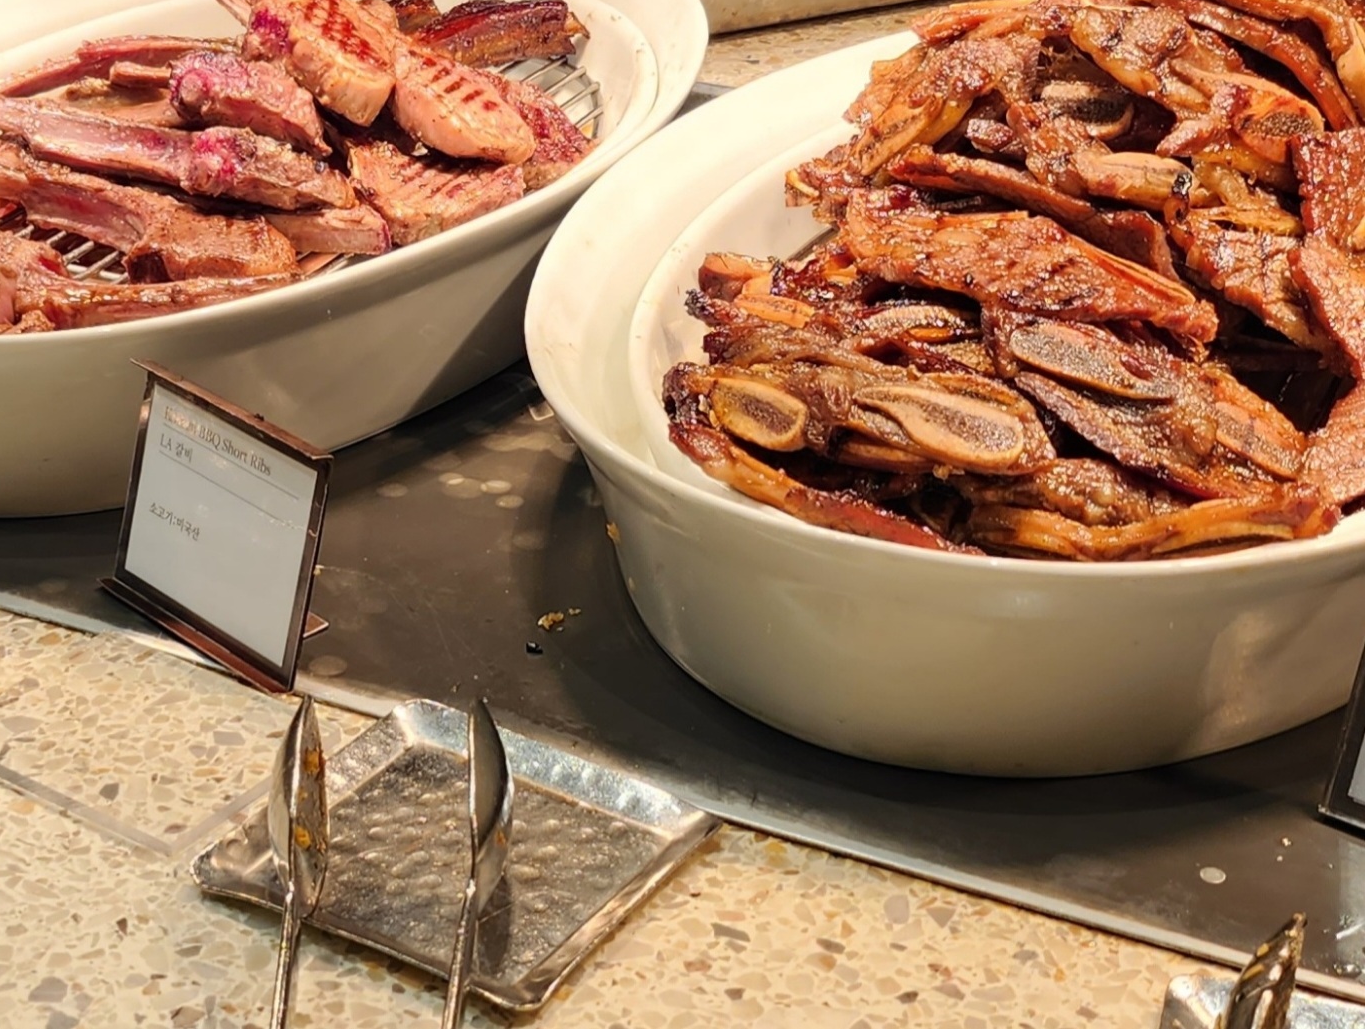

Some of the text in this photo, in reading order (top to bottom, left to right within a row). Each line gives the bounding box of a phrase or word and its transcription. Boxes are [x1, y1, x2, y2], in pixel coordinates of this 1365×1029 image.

[159, 433, 193, 463] LA 갈비
[198, 424, 221, 451] BBQ
[222, 438, 248, 463] Short
[250, 453, 272, 477] Ribs
